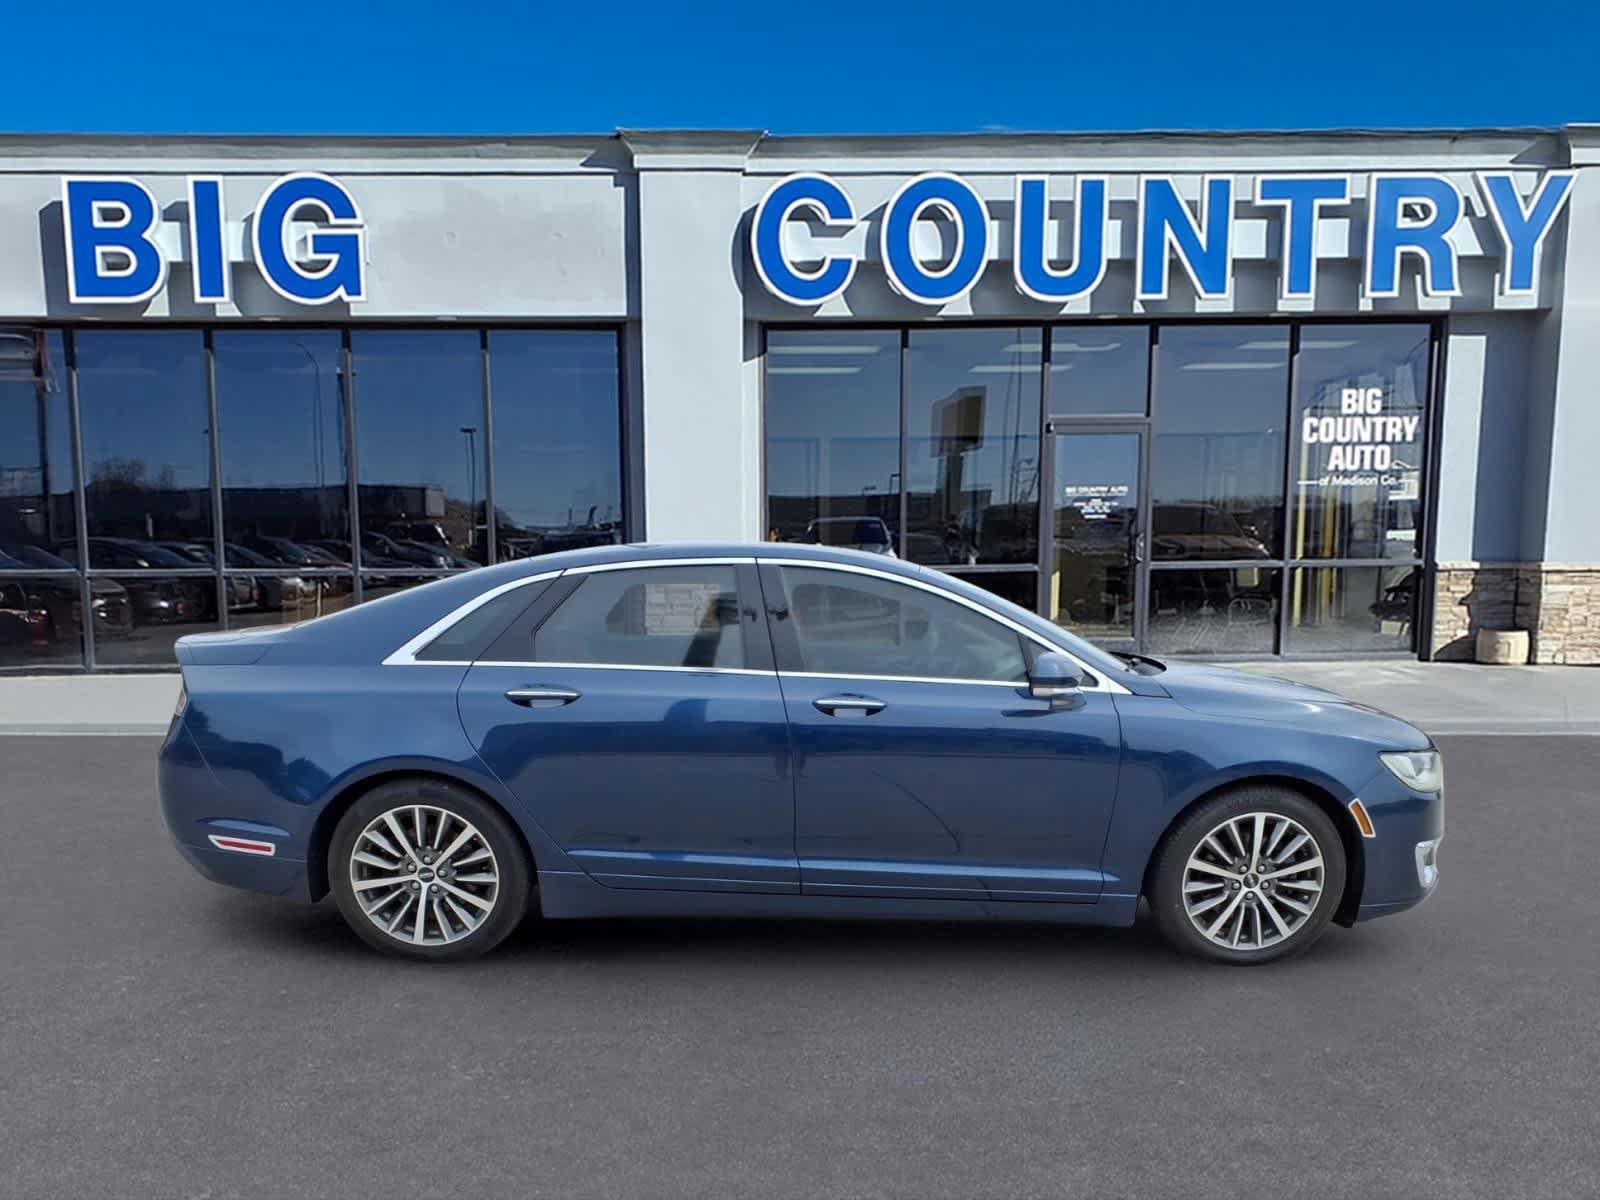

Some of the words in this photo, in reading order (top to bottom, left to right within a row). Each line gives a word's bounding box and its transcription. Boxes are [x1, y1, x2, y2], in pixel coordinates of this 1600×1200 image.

[61, 171, 368, 305] BIG
[750, 171, 1576, 307] COUNTRY
[1341, 388, 1382, 415] BIG
[1302, 416, 1419, 443] COUNTRY
[1328, 444, 1391, 471] AUTO
[1319, 475, 1330, 486] of
[1331, 474, 1377, 485] Madison
